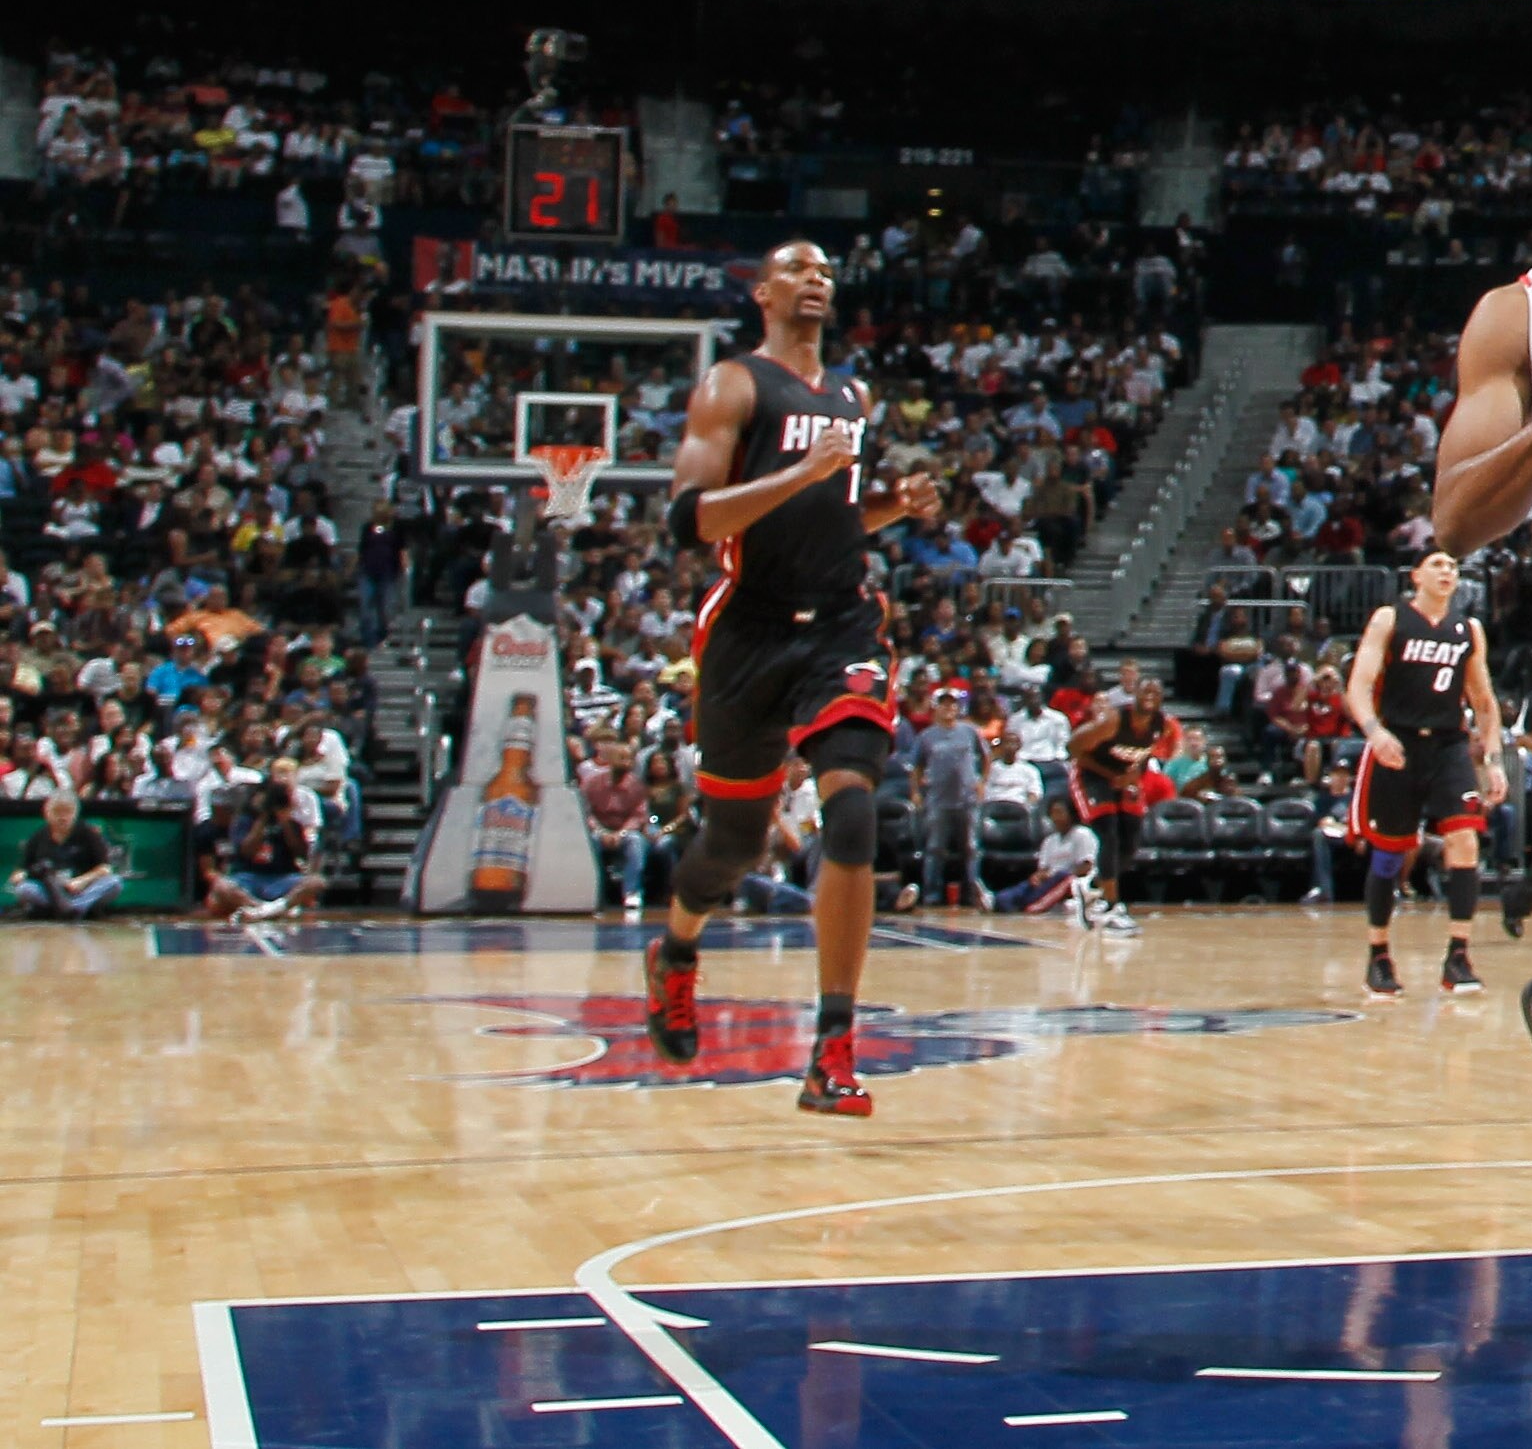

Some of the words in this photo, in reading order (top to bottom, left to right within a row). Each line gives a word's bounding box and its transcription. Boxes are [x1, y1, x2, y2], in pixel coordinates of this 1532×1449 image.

[529, 171, 600, 227] 21
[1402, 637, 1470, 667] HEAT
[1433, 666, 1455, 693] 0
